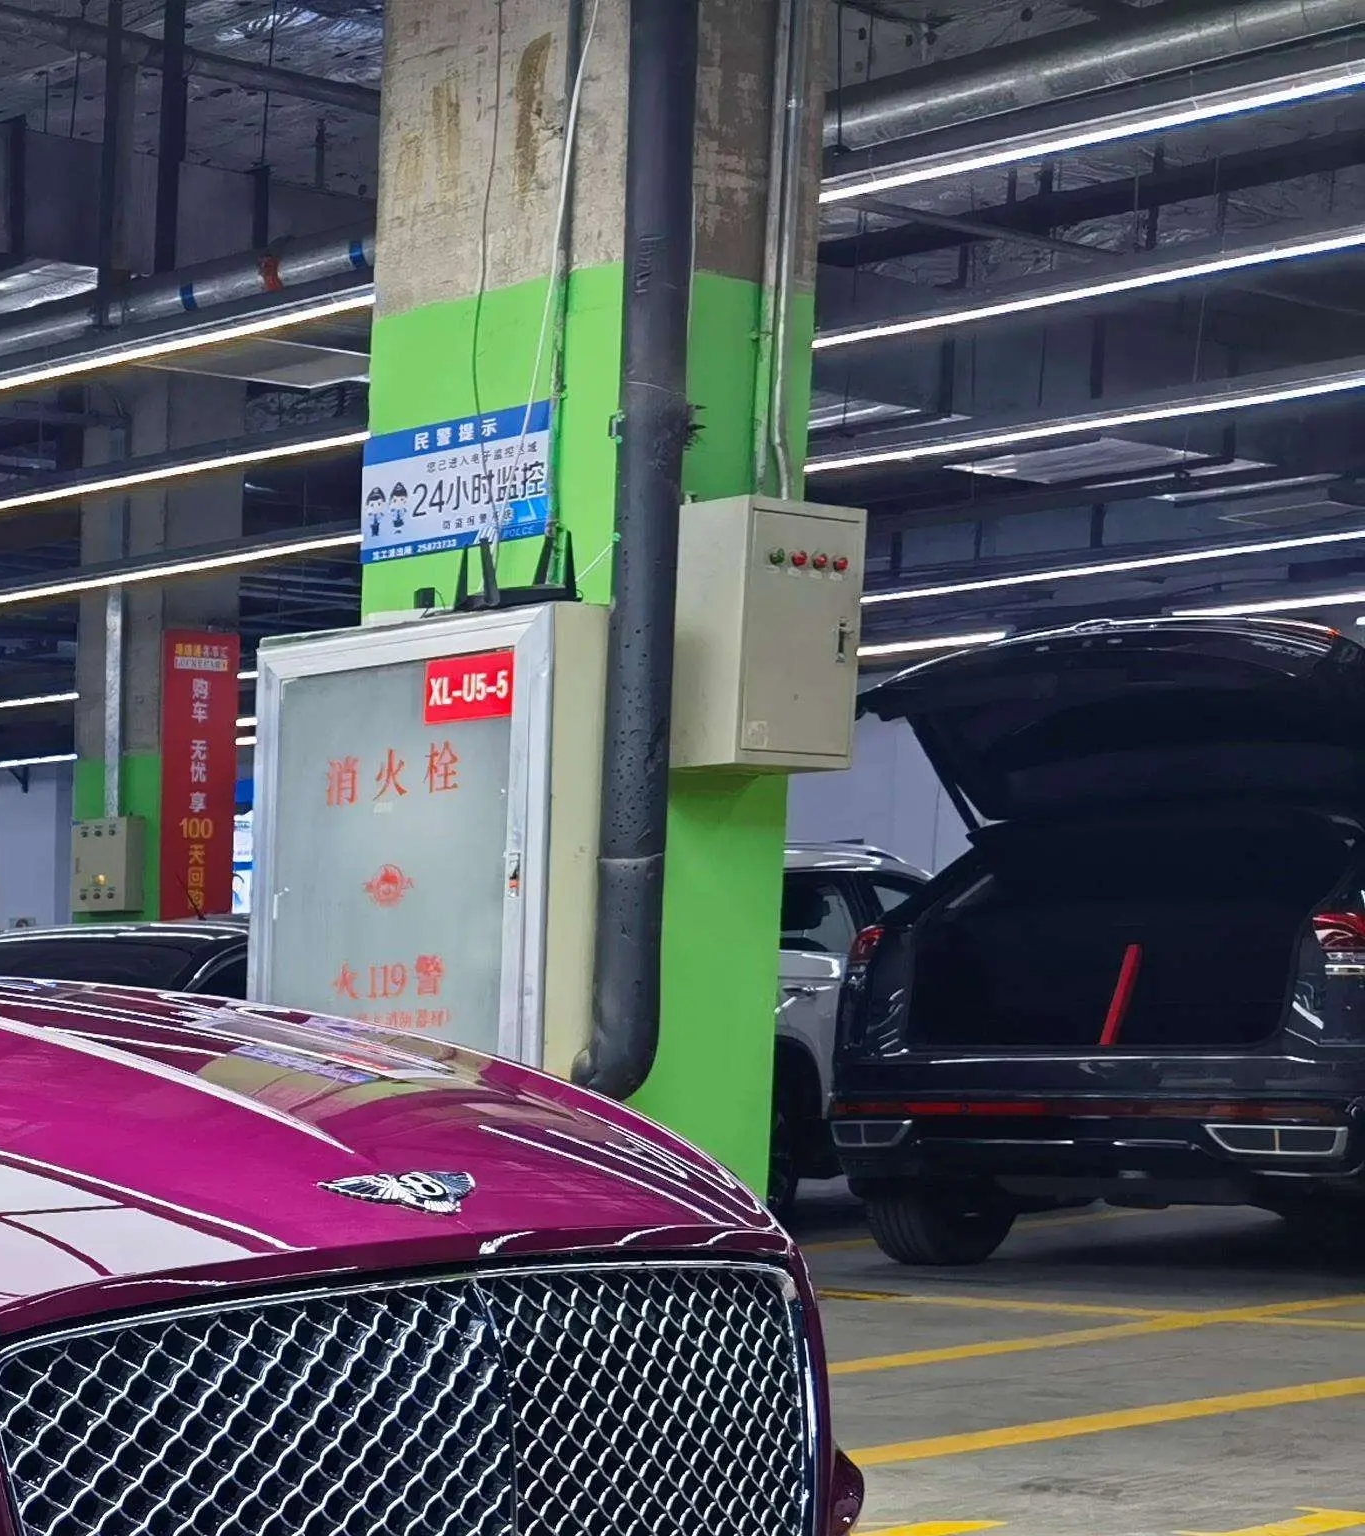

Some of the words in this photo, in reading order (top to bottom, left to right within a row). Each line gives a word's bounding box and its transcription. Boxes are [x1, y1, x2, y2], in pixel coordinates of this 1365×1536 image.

[414, 418, 498, 452] 民警提示
[412, 461, 545, 518] 24小时监控
[428, 669, 509, 706] XL-U5-5
[326, 739, 460, 808] 消火栓
